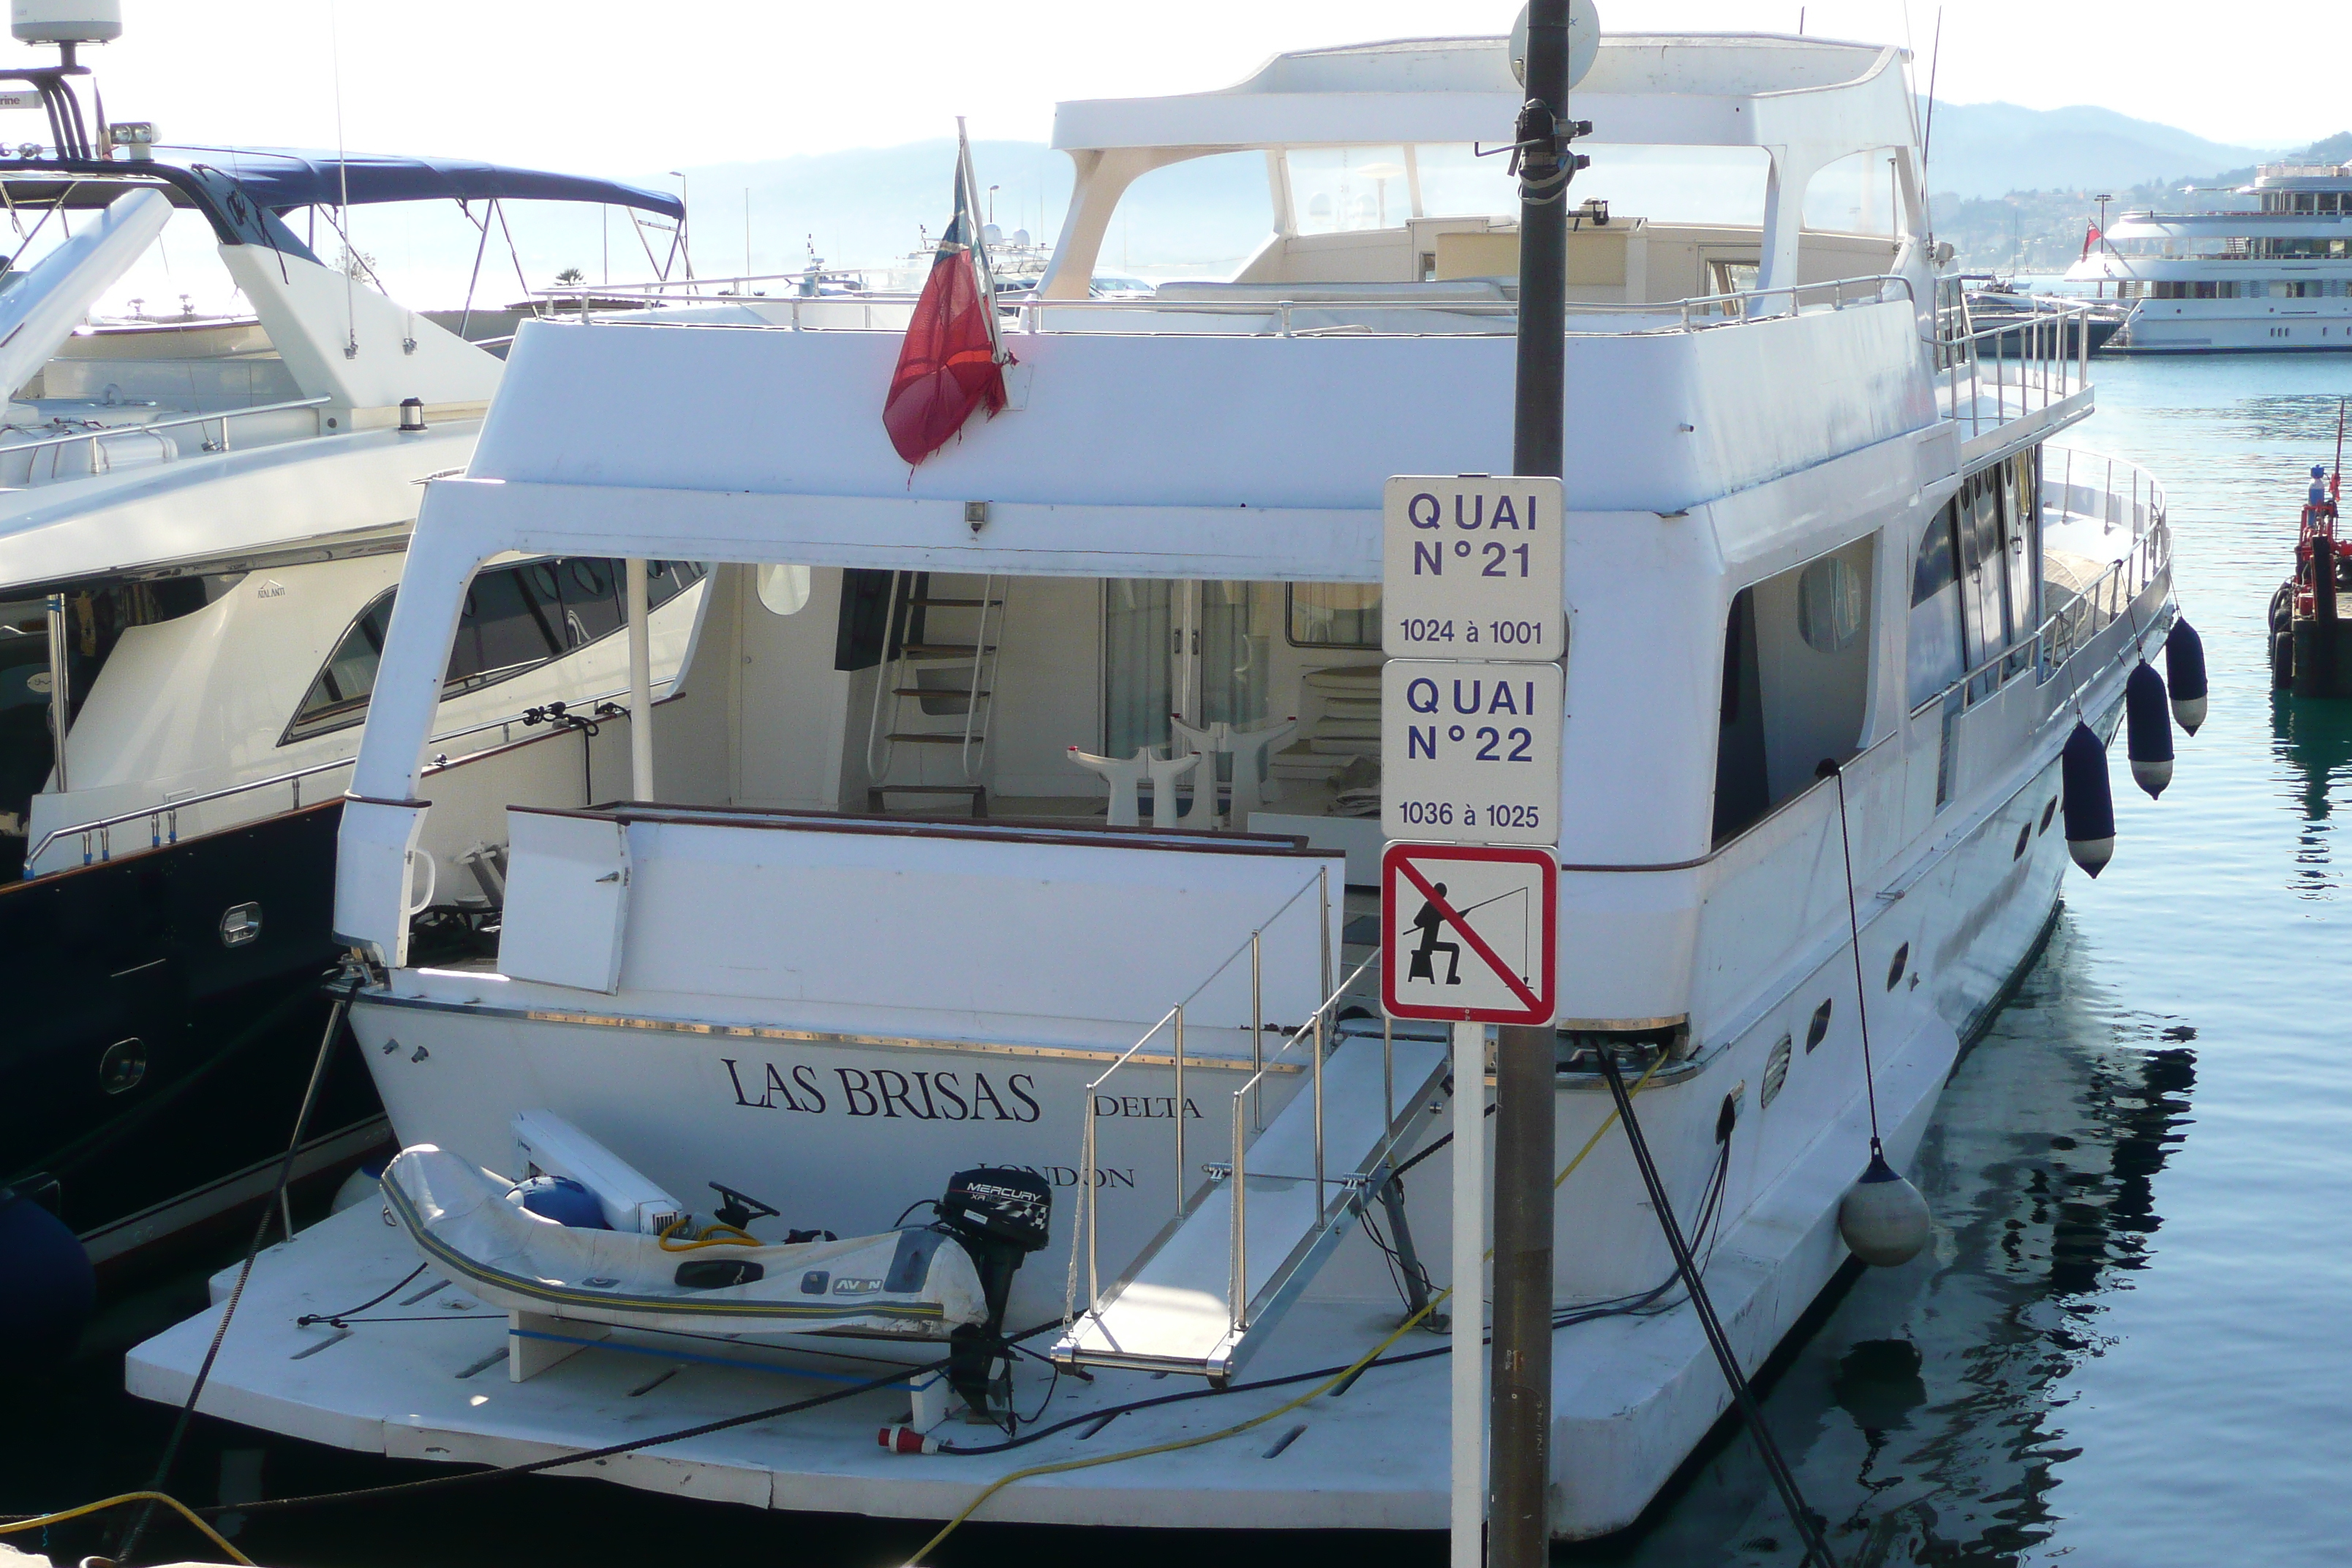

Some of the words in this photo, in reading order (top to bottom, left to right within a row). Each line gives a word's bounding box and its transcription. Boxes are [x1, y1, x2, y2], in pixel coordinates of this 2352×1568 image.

[1408, 493, 1536, 529] QUAI
[1401, 619, 1455, 641] 1024
[1466, 620, 1479, 642] à
[1490, 621, 1541, 644] 1001
[1407, 677, 1534, 715] QUAI
[1399, 802, 1453, 825] 1036
[1463, 804, 1476, 826] à
[1486, 804, 1539, 828] 1025
[720, 1058, 826, 1114] LAS
[834, 1068, 1041, 1123] BRISAS
[1094, 1096, 1204, 1118] DELTA
[967, 1183, 1042, 1202] MERCURY
[837, 1280, 881, 1292] AVON
